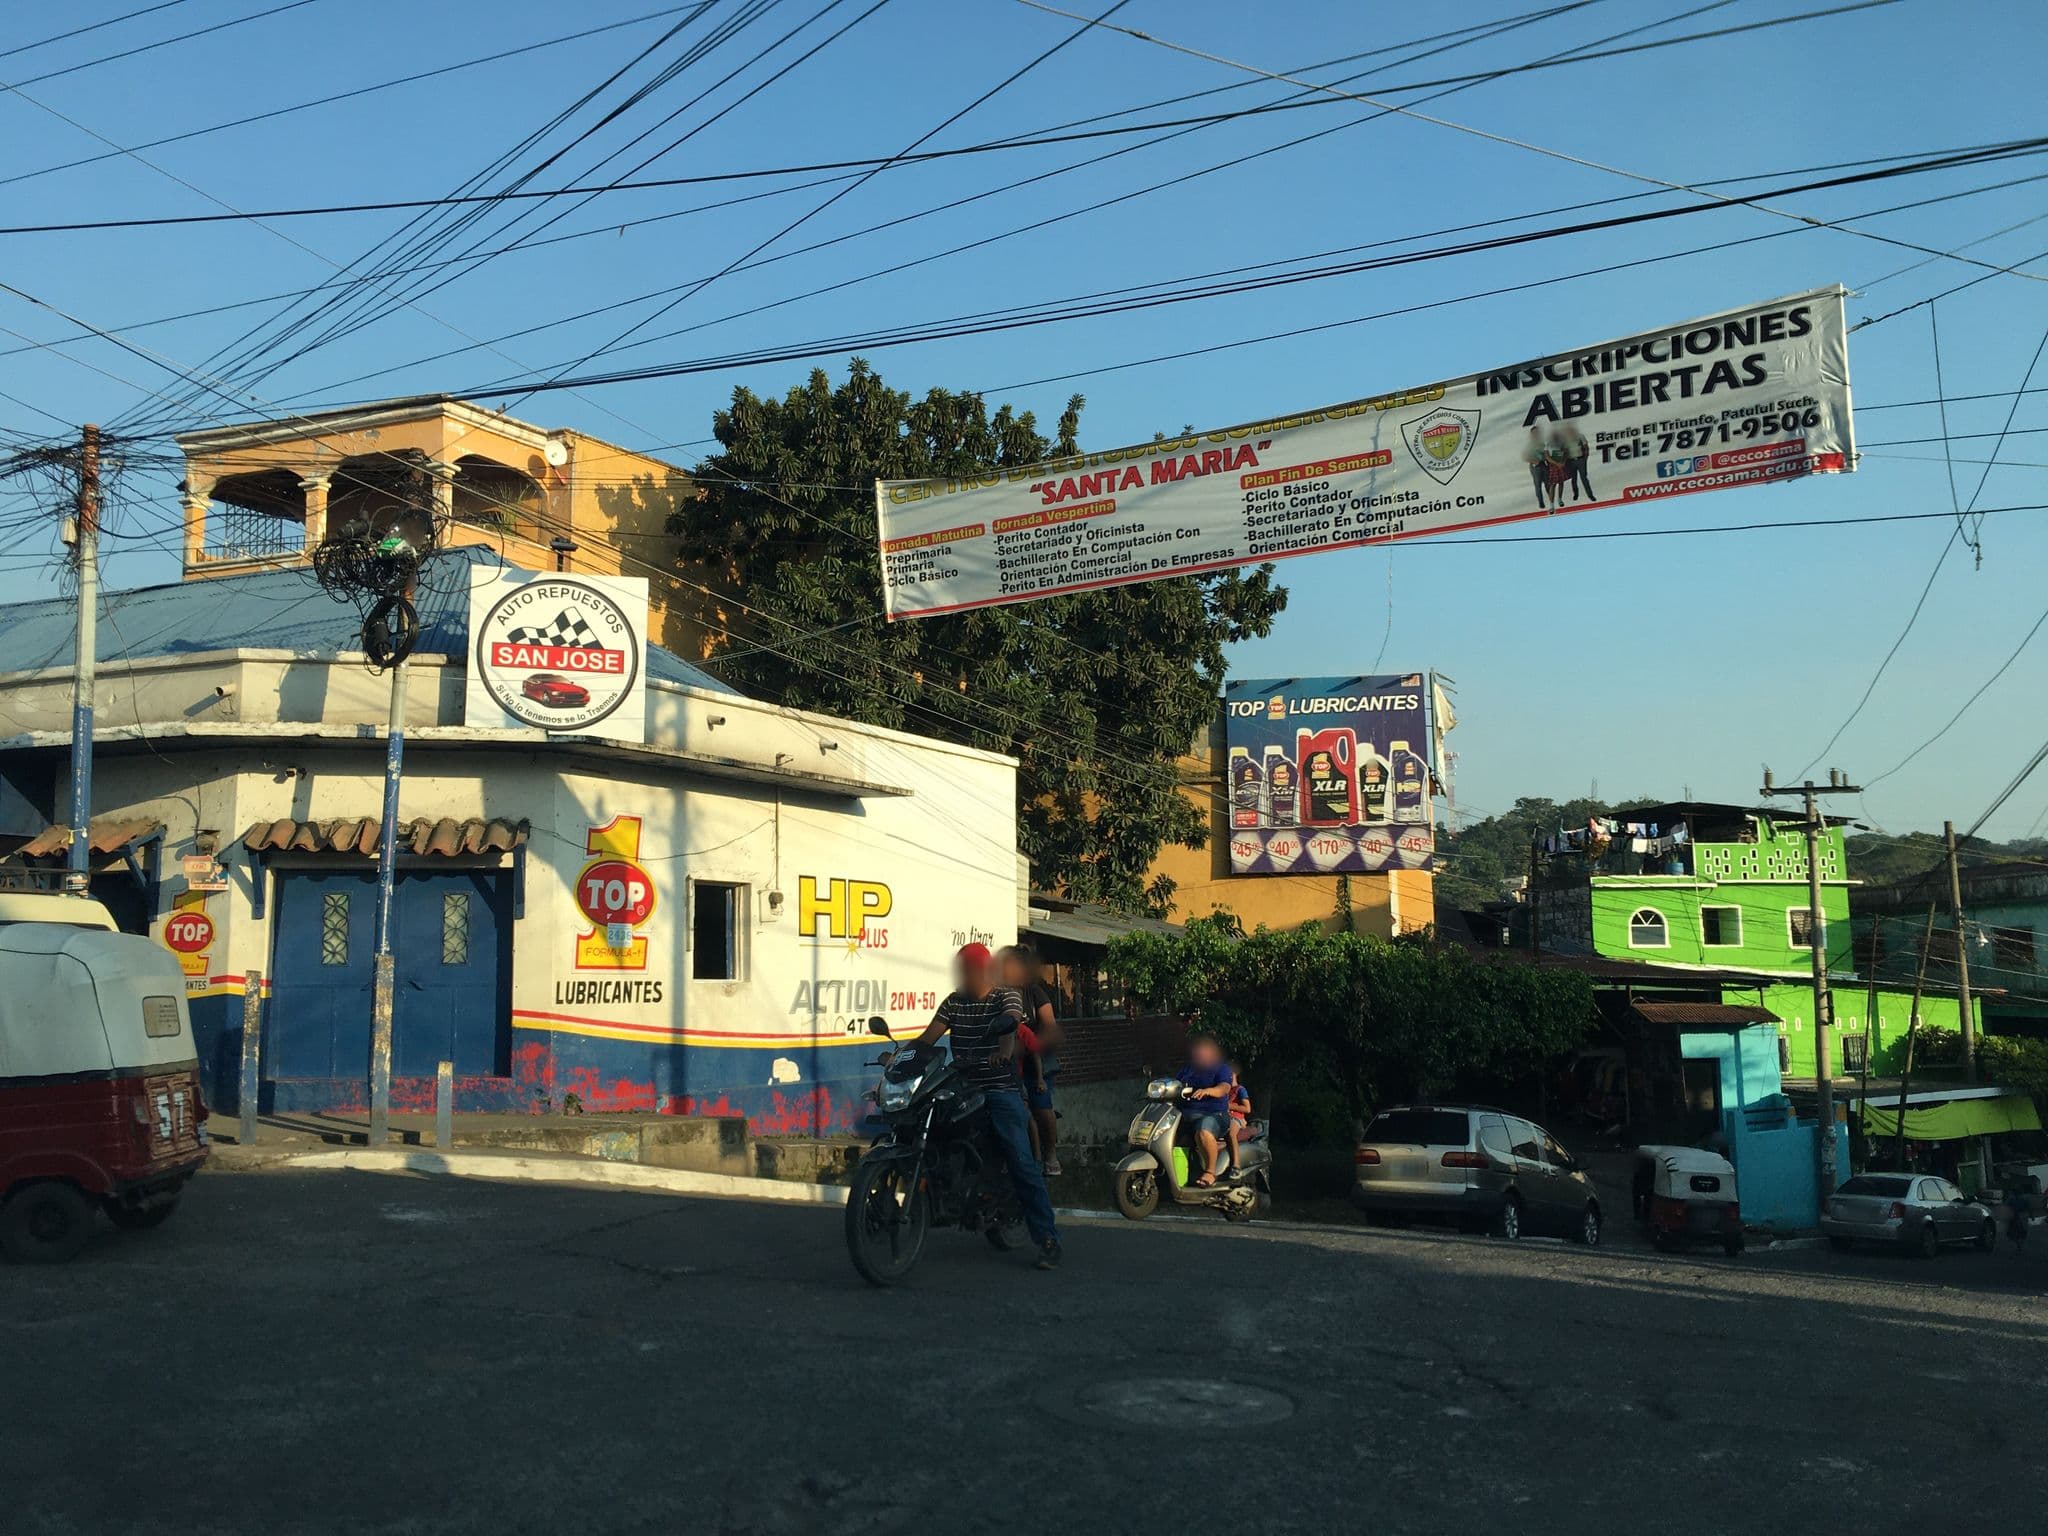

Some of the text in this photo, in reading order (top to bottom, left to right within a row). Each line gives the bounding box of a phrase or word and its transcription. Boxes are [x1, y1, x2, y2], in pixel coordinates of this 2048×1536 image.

[1476, 307, 1813, 397] INSCRIPCIONES
[1522, 353, 1768, 427] ABIERTAS
[1596, 426, 1641, 444] Barrio
[1643, 422, 1658, 434] El
[1659, 414, 1719, 432] Triunfo,
[1777, 395, 1819, 412] Such.
[1596, 408, 1822, 464] Tel: 7871-9506
[1717, 443, 1802, 465] @cecosama
[1244, 453, 1388, 488] Plan Fin De Semana
[1629, 455, 1821, 499] www.cecosama.edu.gt
[1284, 480, 1330, 497] Básico
[1290, 488, 1353, 508] Contador
[1334, 517, 1351, 528] En
[1356, 500, 1451, 524] Computación
[1456, 494, 1485, 508] Con
[1338, 503, 1346, 515] y
[1350, 490, 1419, 510] Oficinista
[993, 501, 1115, 532] Jornada Vespertina
[1034, 521, 1088, 539] Contador
[931, 526, 982, 543] Matutina
[1072, 545, 1089, 557] En
[1091, 532, 1173, 554] Computación
[1175, 528, 1201, 539] Con
[1075, 533, 1083, 545] y
[1086, 522, 1145, 541] Oficinista
[1249, 520, 1404, 555] Orientación Comercial
[919, 568, 959, 583] Básico
[1000, 551, 1132, 583] Orientación Comercial
[1038, 577, 1054, 588] En
[1056, 561, 1148, 585] Administración
[1151, 558, 1168, 569] De
[1171, 548, 1235, 566] Empresas
[497, 586, 623, 634] AUTO REPUESTOS
[498, 646, 620, 671] SAN JOSE
[502, 692, 515, 706] No
[514, 702, 524, 712] lo
[525, 708, 563, 724] tenemos
[564, 715, 576, 724] se
[576, 713, 586, 722] lo
[586, 692, 619, 717] Traemos
[1229, 701, 1266, 717] TOP
[1289, 694, 1419, 715] LUBRICANTES
[1313, 780, 1347, 792] XLR
[1362, 784, 1386, 793] XLR
[587, 879, 646, 911] TOP
[799, 875, 893, 938] HP
[172, 922, 209, 942] TOP
[857, 927, 889, 949] PLUS
[555, 980, 664, 1006] LUBRICANTES
[789, 979, 889, 1015] ACTION
[890, 991, 936, 1011] 20W-50
[847, 1017, 866, 1035] 4T
